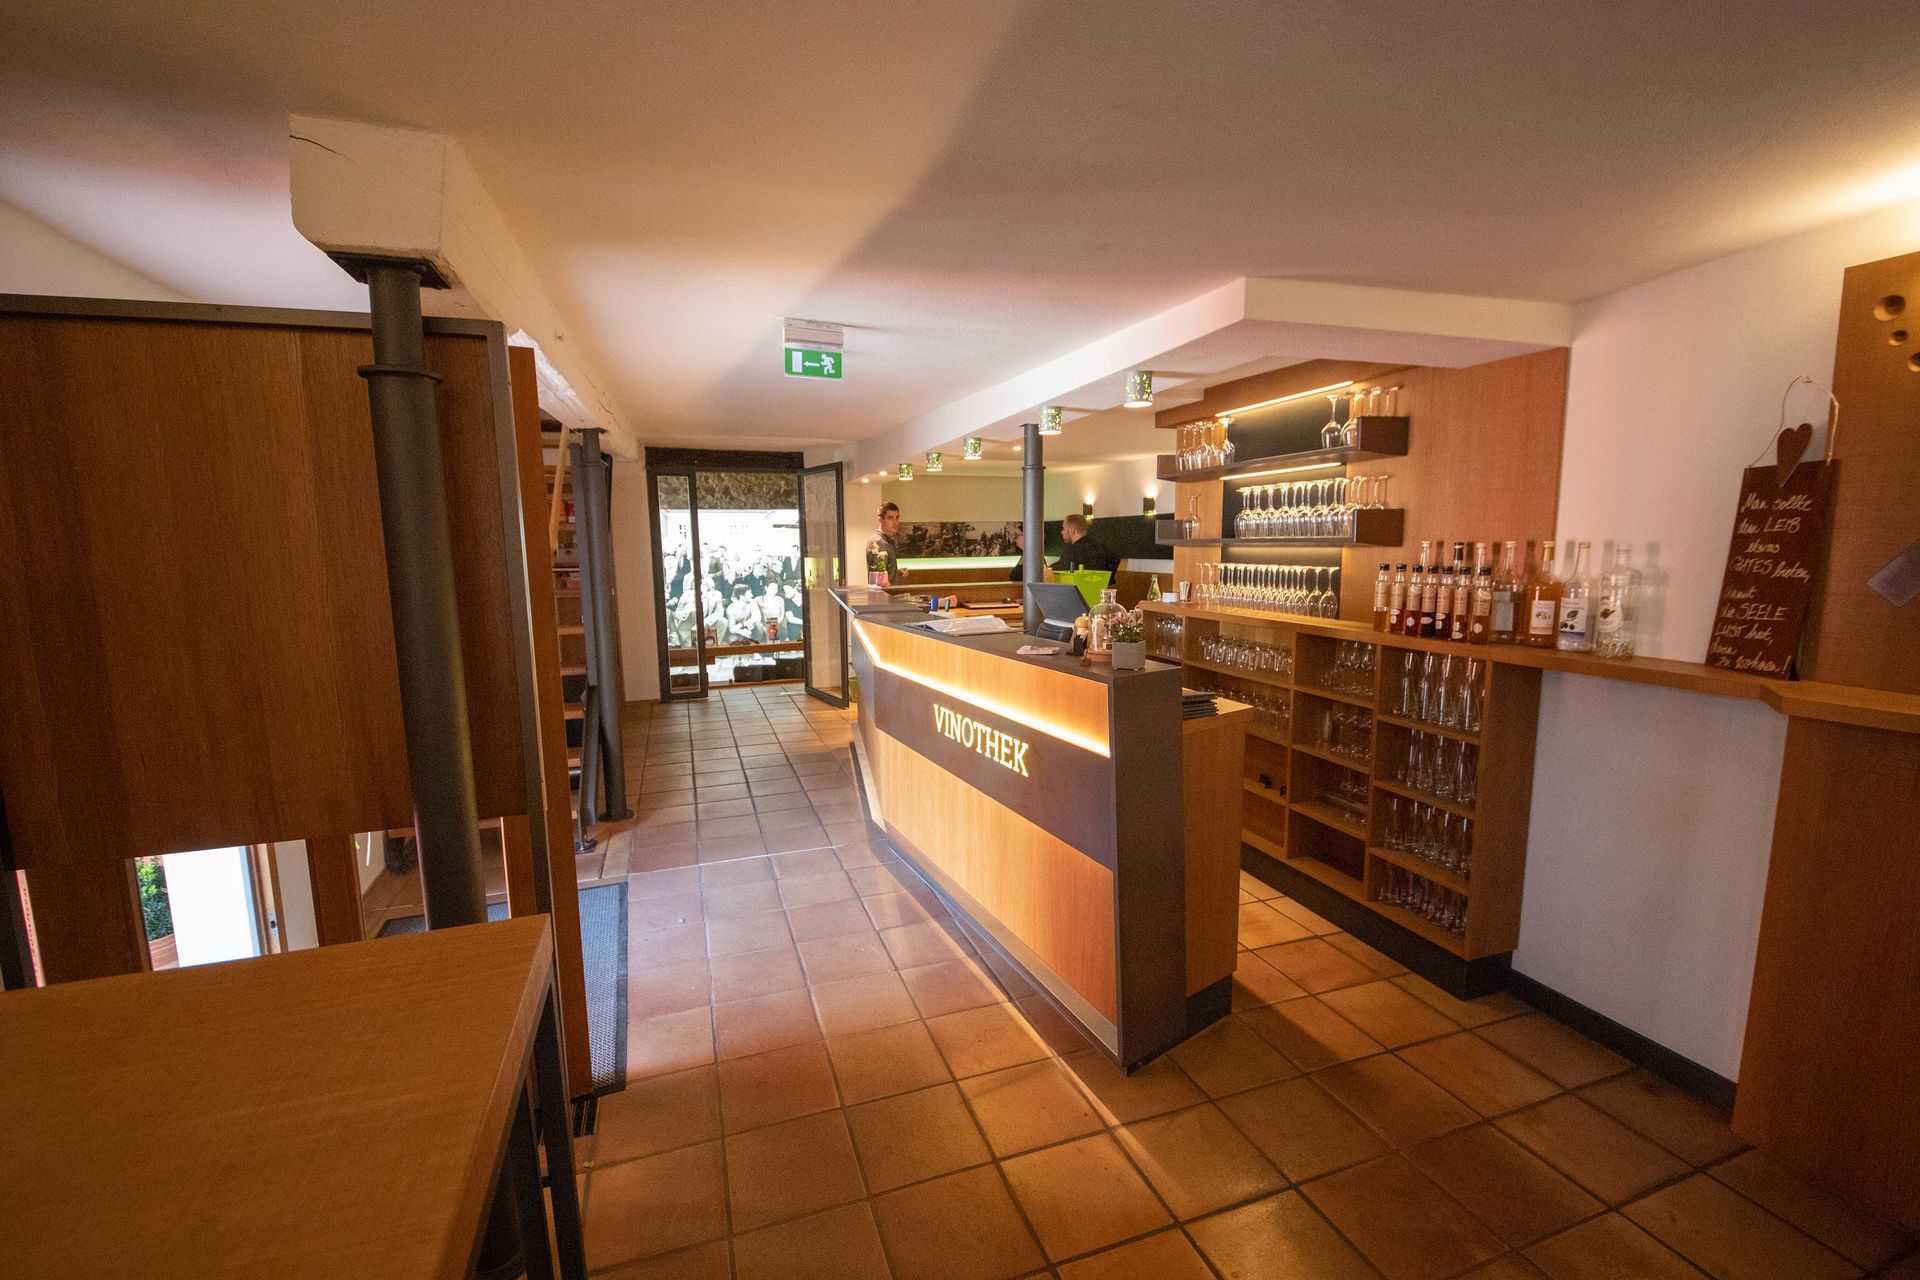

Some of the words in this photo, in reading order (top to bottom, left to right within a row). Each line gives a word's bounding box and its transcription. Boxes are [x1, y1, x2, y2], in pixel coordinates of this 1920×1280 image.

[1741, 493, 1769, 513] Man
[1773, 495, 1812, 511] sollte
[1764, 516, 1801, 533] LEIB
[1745, 539, 1780, 554] etwas
[1733, 556, 1773, 574] GUTES
[1738, 603, 1788, 620] SEELE
[1714, 622, 1749, 638] LUST
[933, 703, 1029, 778] VINOTHEK
